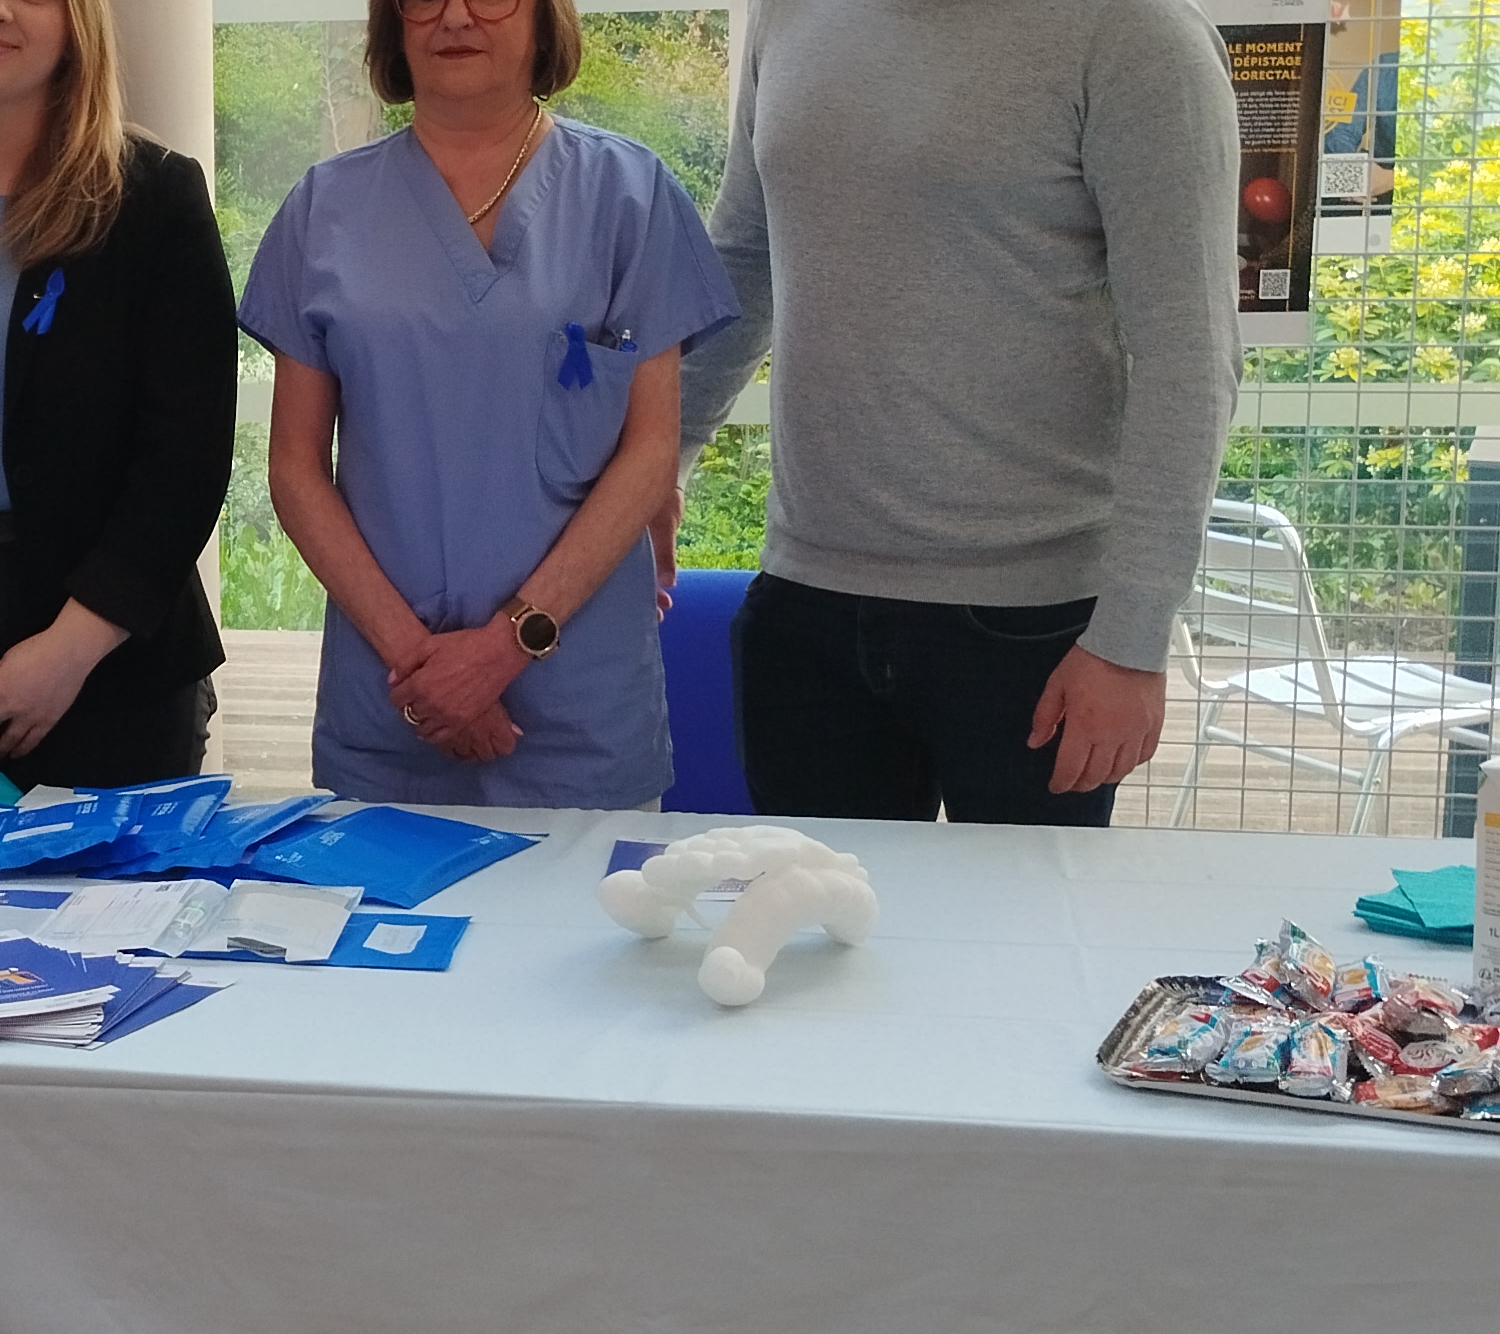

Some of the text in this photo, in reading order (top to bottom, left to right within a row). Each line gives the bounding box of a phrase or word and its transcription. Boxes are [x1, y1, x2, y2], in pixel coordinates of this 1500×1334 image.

[1228, 42, 1303, 54] LE MOMENT
[1233, 54, 1302, 67] DÉPISTAGE
[1230, 70, 1302, 81] LORECTAL.
